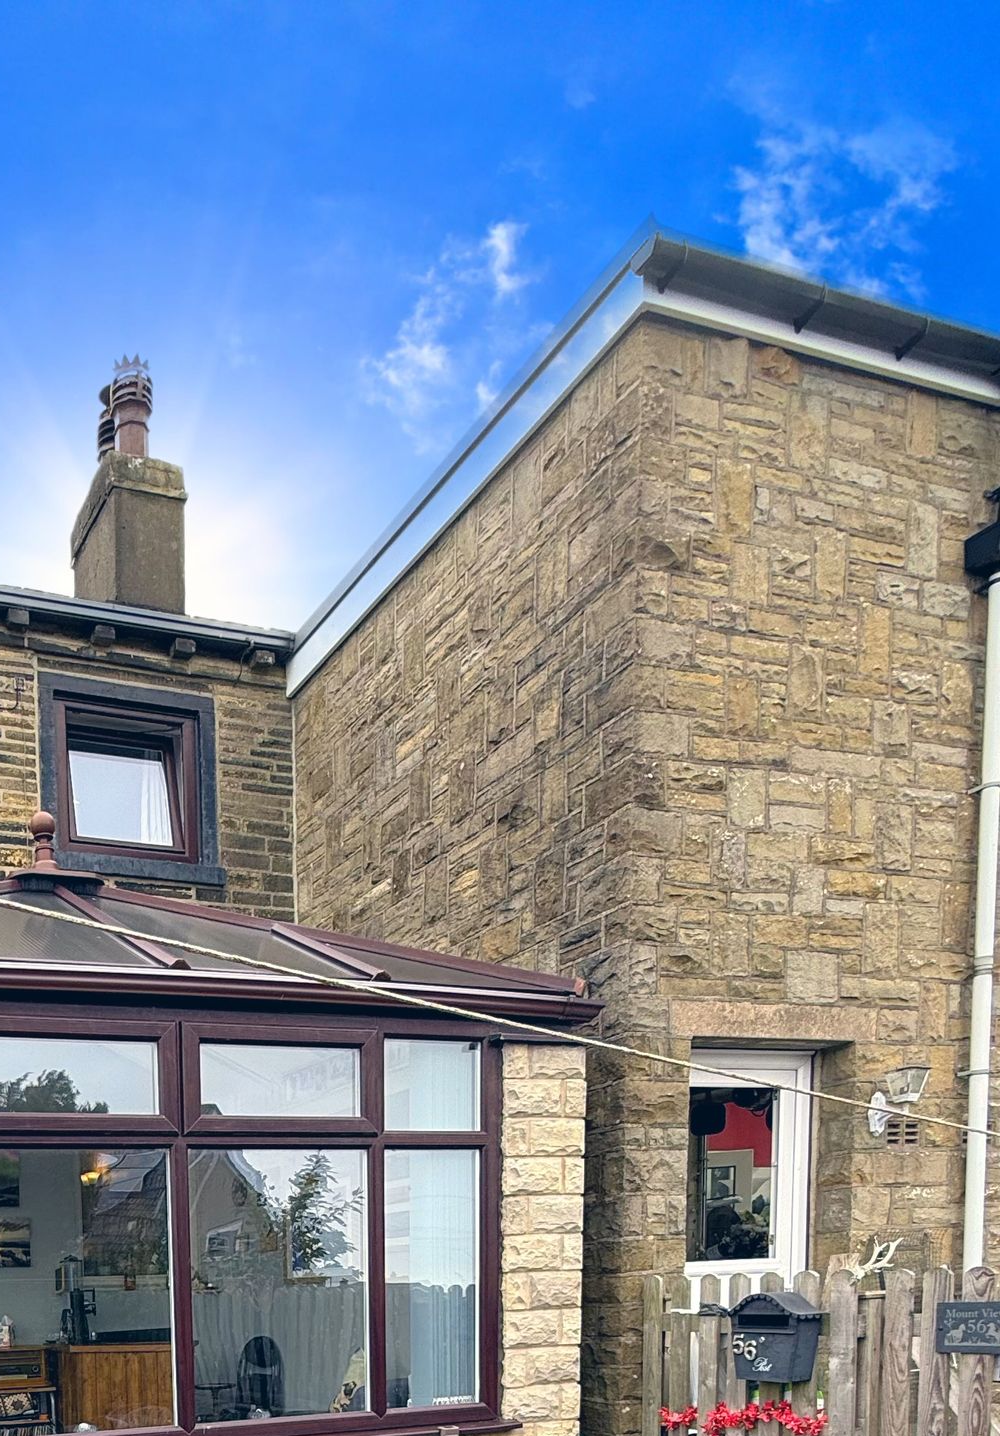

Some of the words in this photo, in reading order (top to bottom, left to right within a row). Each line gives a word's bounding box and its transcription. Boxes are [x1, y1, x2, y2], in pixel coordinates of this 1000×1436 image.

[945, 1309, 978, 1318] Mount
[982, 1309, 1000, 1318] Vie
[967, 1319, 987, 1334] 56
[732, 1333, 757, 1361] 56
